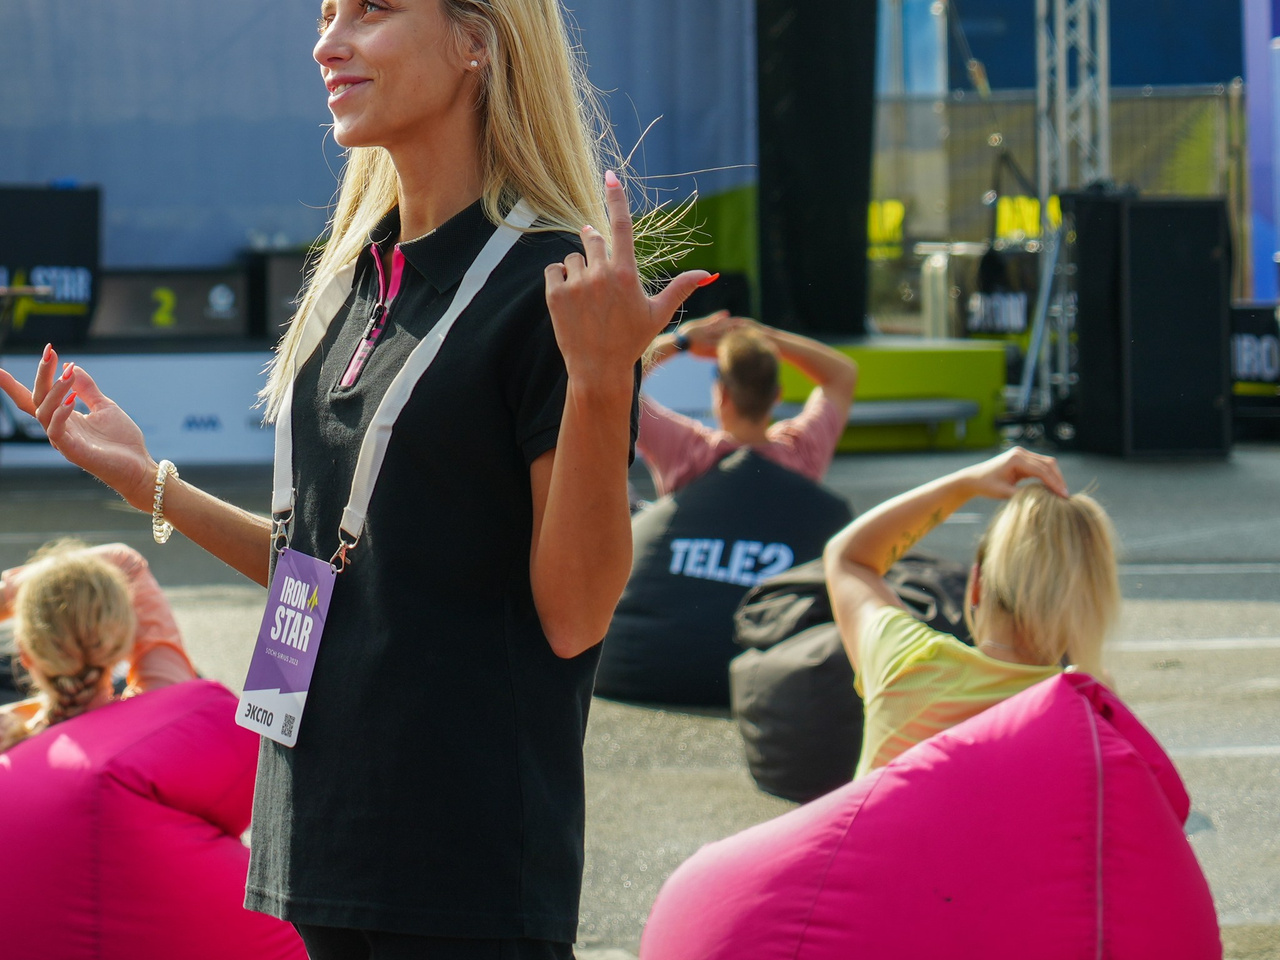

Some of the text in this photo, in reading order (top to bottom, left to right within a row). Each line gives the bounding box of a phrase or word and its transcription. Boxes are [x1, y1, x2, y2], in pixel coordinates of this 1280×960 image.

[152, 287, 176, 327] 2
[669, 538, 795, 587] TELE2
[279, 575, 310, 611] IRON
[270, 605, 314, 652] STAR
[244, 703, 274, 728] ЭКСПО
